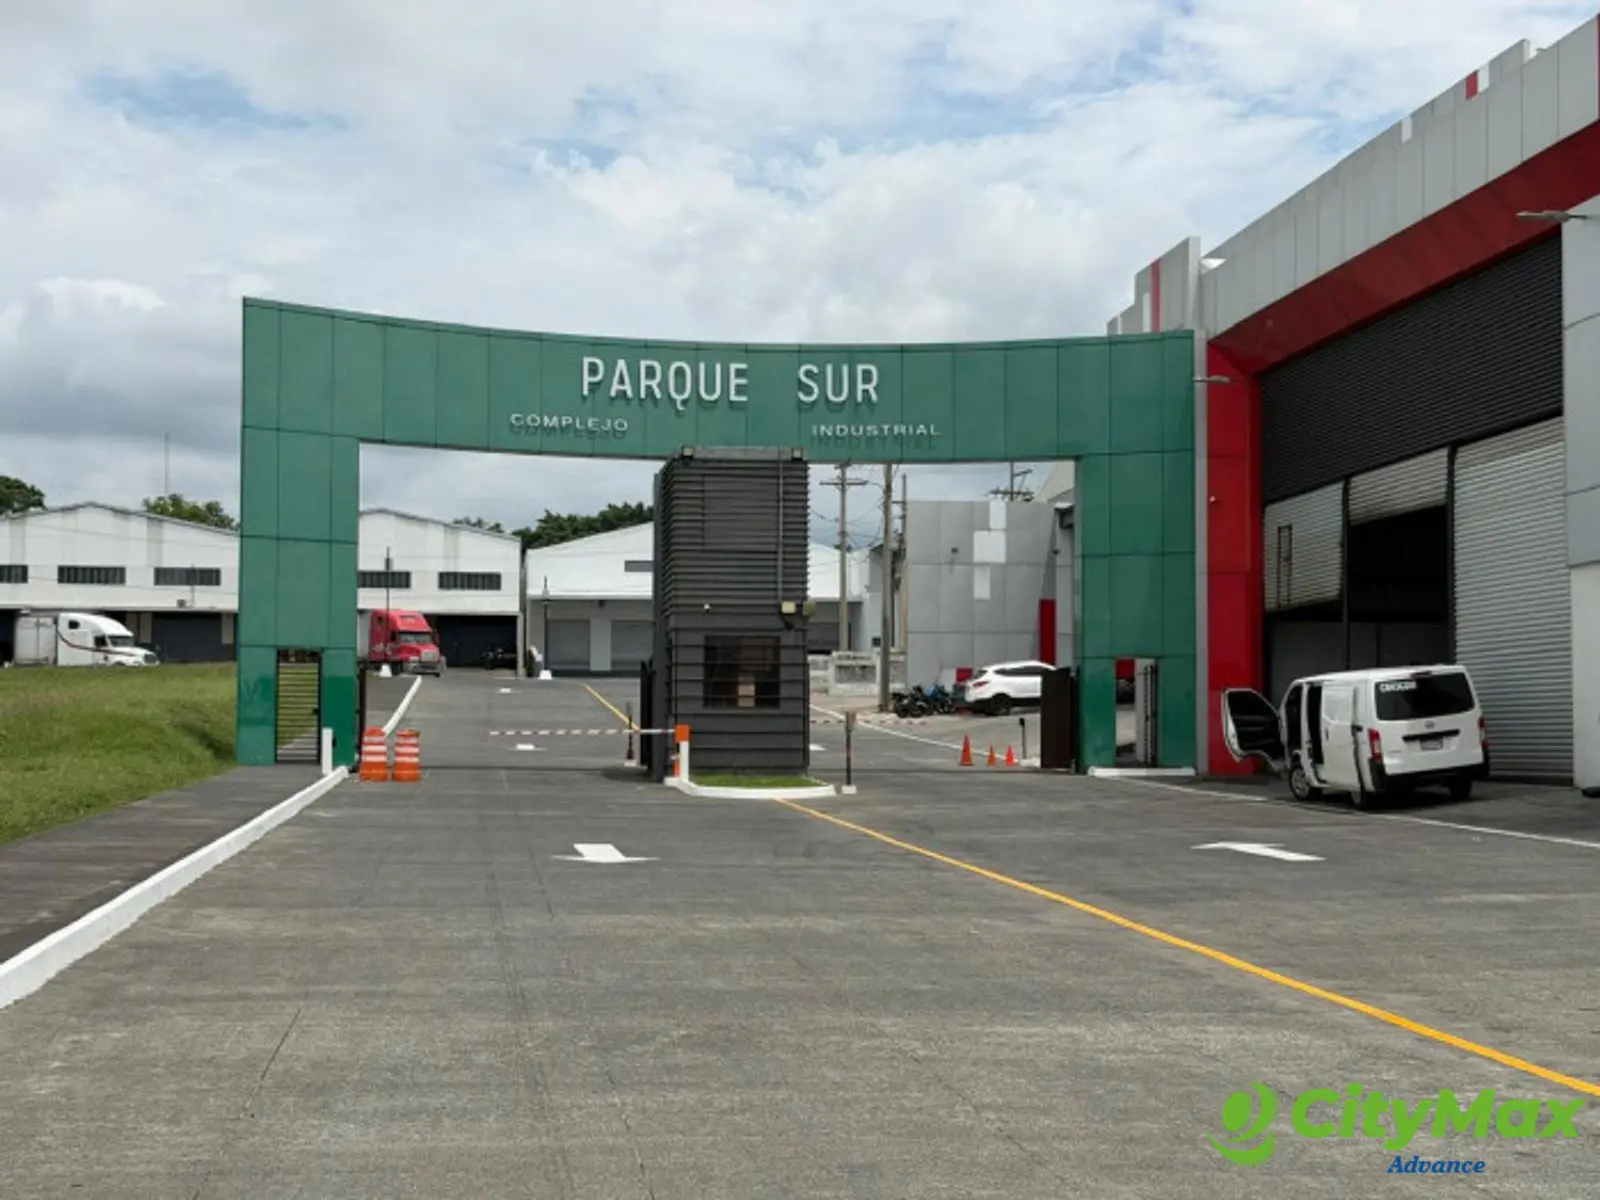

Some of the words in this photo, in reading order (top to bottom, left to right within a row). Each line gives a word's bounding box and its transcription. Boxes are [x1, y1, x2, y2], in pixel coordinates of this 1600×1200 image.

[581, 356, 749, 411] PARQUE
[797, 363, 880, 403] SUR
[510, 413, 629, 433] COMPLEJO
[811, 423, 942, 437] INDUSTRIAL
